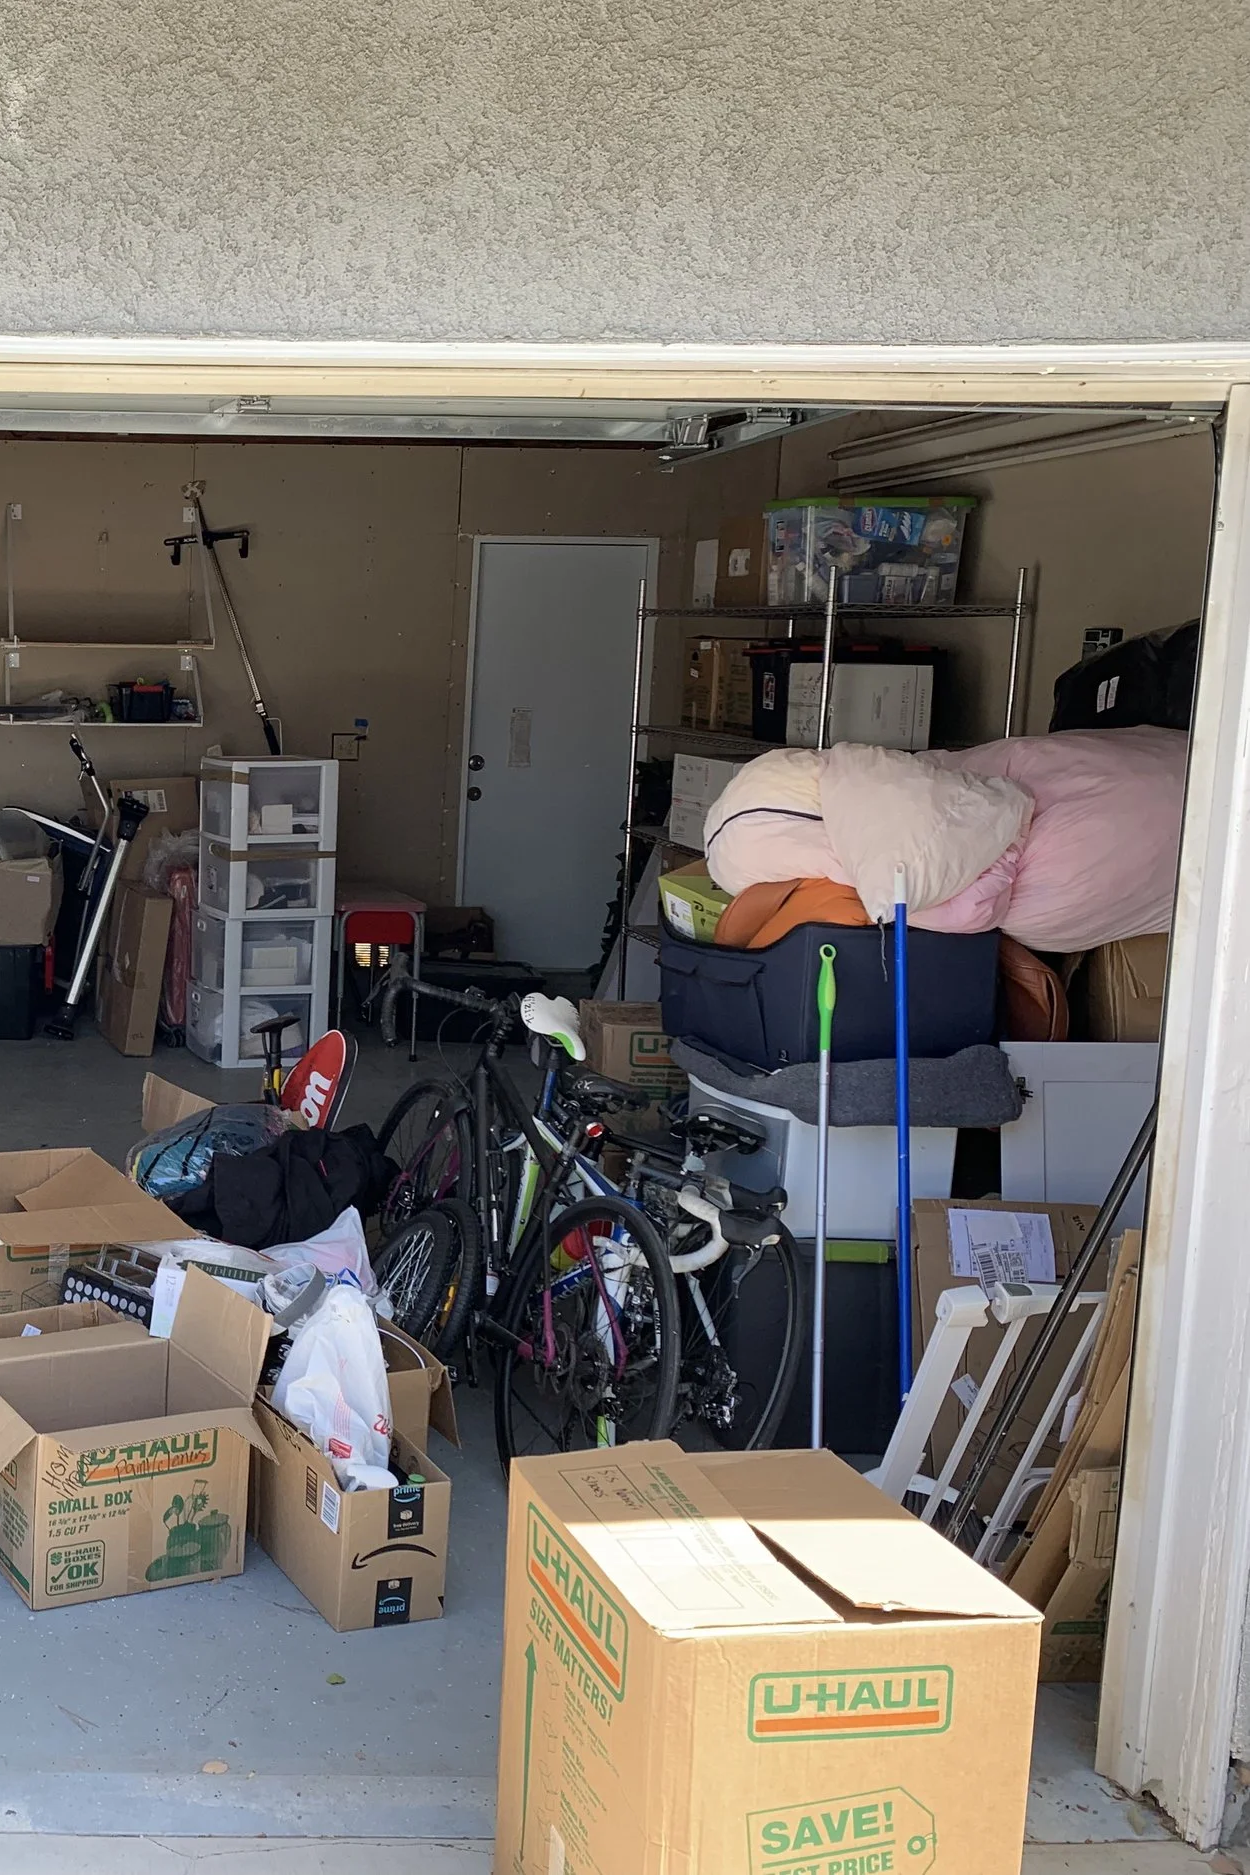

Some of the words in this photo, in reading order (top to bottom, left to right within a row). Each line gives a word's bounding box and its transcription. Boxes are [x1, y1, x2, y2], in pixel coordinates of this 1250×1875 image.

[393, 1486, 421, 1498] prime
[48, 1496, 99, 1516] SMALL
[104, 1489, 133, 1507] BOX
[48, 1528, 61, 1538] 1.5
[64, 1526, 76, 1536] CU
[78, 1524, 90, 1534] FT
[63, 1545, 102, 1559] U-HAUL
[63, 1552, 102, 1564] BOXES
[67, 1562, 100, 1578] OK
[49, 1582, 65, 1593] FOR
[65, 1577, 100, 1590] SHIPPING
[532, 1519, 619, 1662] U-HAUL
[378, 1603, 406, 1615] prime
[530, 1596, 553, 1644] SIZE
[553, 1630, 614, 1727] MATTERS!
[763, 1678, 939, 1714] U-HAUL
[761, 1801, 895, 1855] SAVE!
[827, 1851, 894, 1875] PRICE
